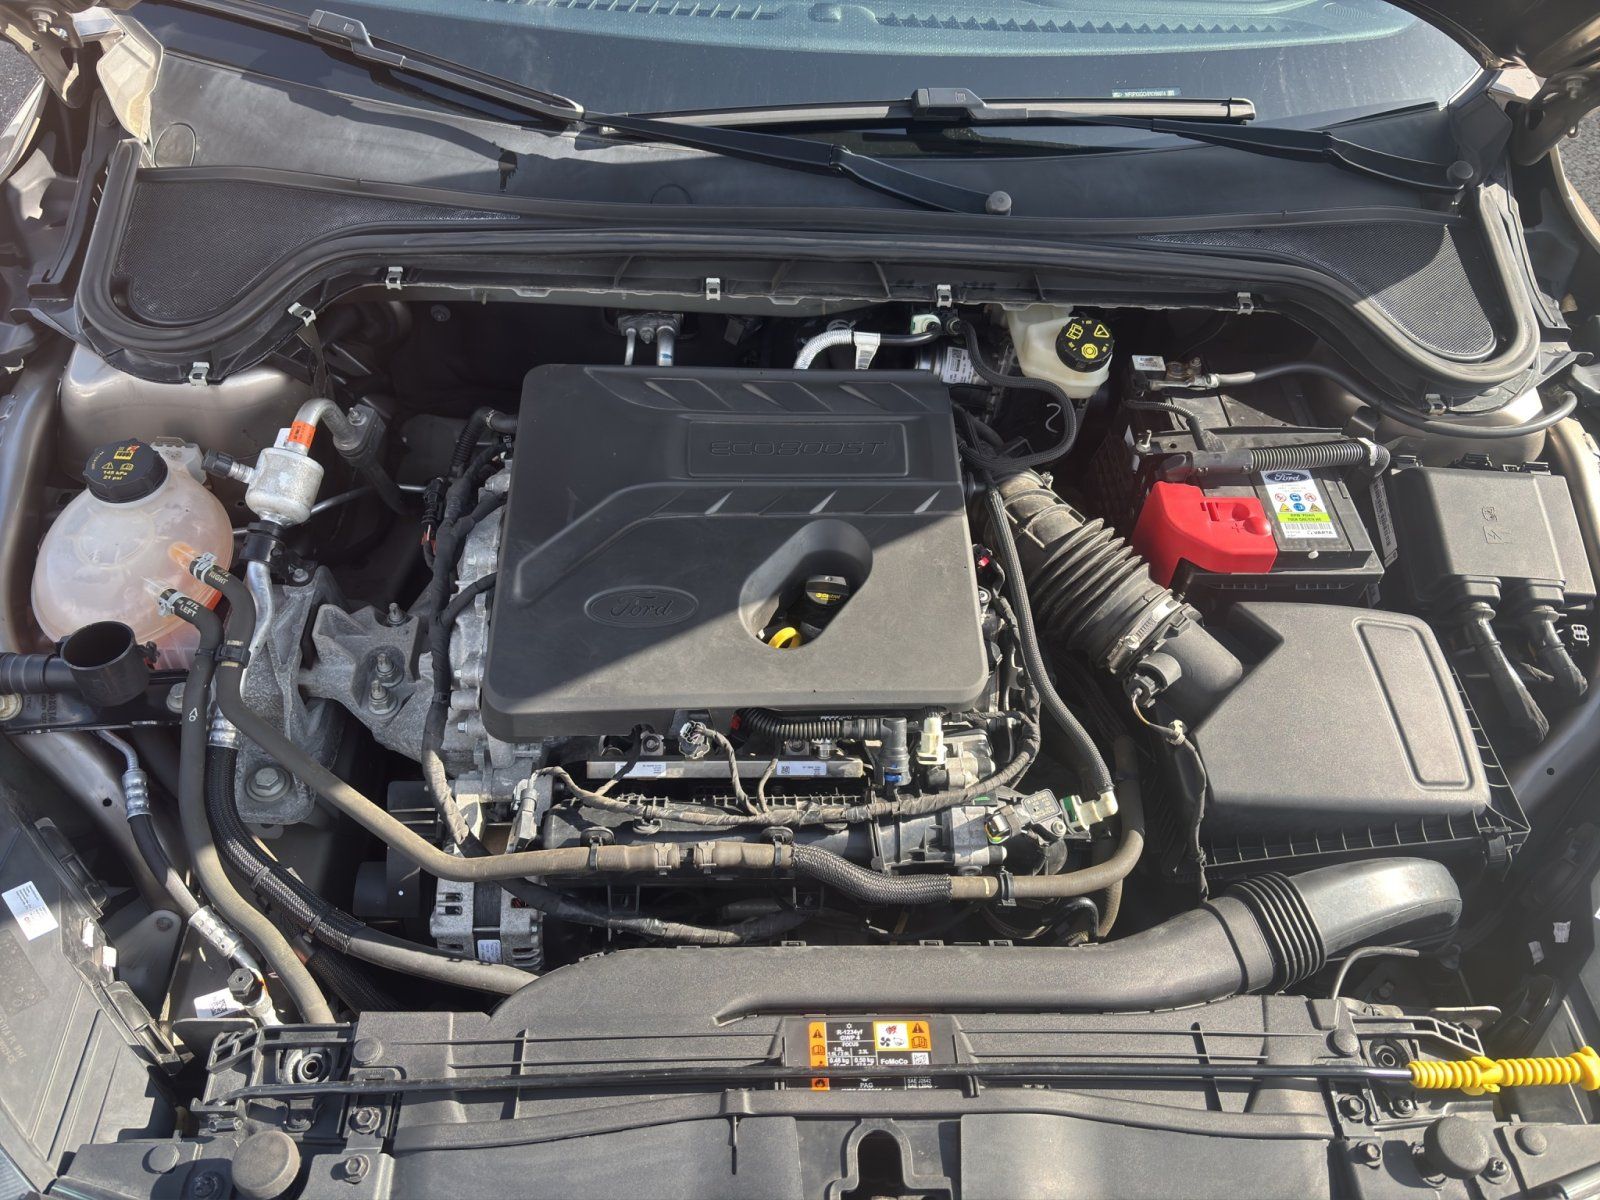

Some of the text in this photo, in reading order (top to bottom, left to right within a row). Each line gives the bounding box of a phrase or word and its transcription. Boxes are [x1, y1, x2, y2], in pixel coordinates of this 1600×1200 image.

[710, 440, 887, 456] ECOBOOST
[208, 571, 229, 585] RIGHT
[180, 604, 197, 617] LEFT
[609, 595, 674, 617] Ford
